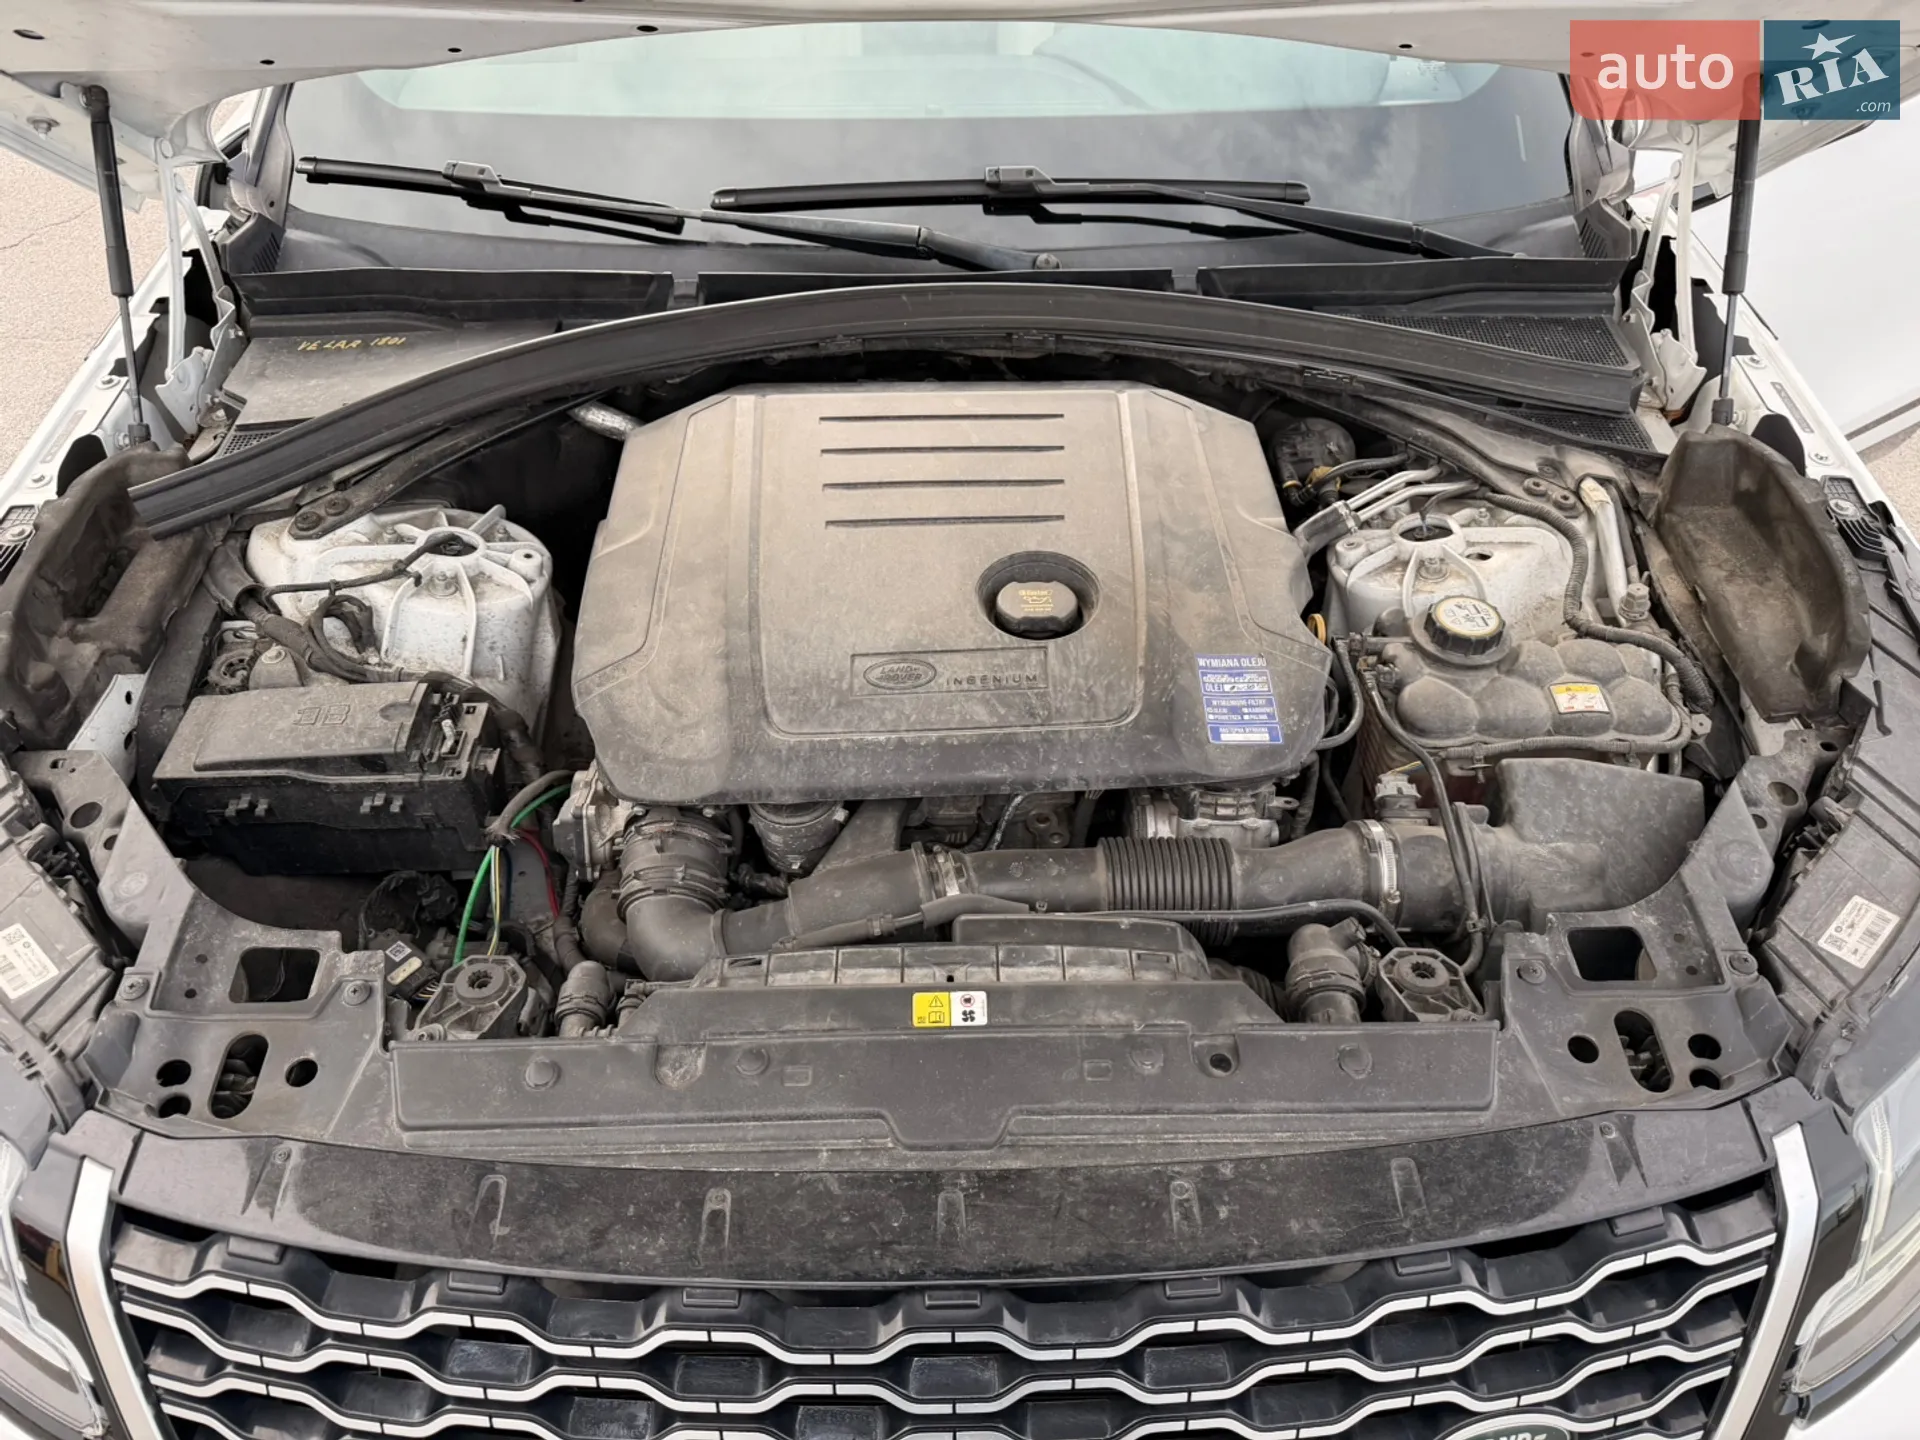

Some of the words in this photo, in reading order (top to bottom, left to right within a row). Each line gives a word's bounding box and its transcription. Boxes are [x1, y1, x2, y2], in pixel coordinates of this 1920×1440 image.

[1197, 657, 1240, 668] WYMIANA
[1240, 657, 1267, 667] OLEJU
[946, 673, 1038, 687] INGENIUM
